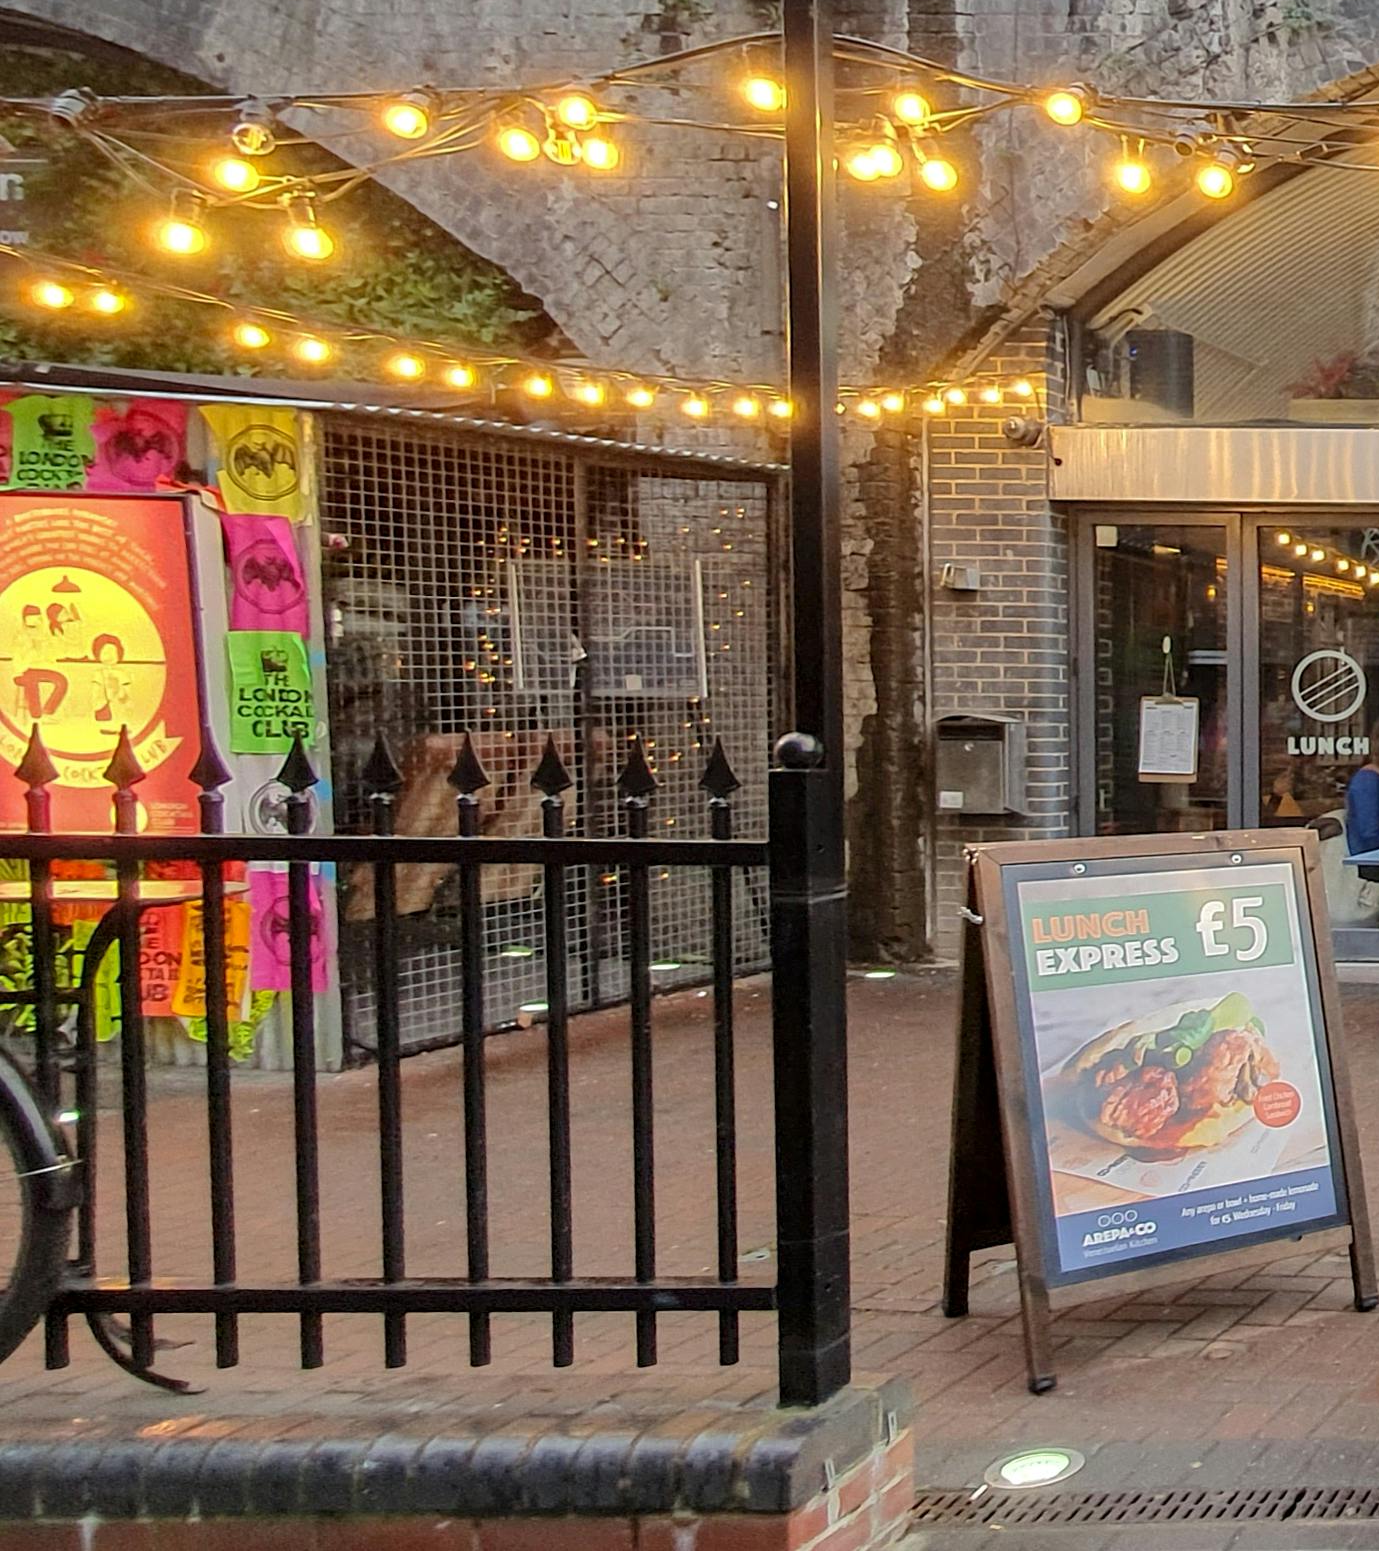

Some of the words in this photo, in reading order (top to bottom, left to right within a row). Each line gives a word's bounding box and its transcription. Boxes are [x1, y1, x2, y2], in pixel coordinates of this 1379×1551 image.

[1287, 737, 1370, 756] LUNCH
[1031, 909, 1150, 944] LUNCH
[1196, 896, 1268, 962] £5
[1036, 937, 1180, 977] EXPRESS
[1082, 1221, 1157, 1247] AREPA&CO
